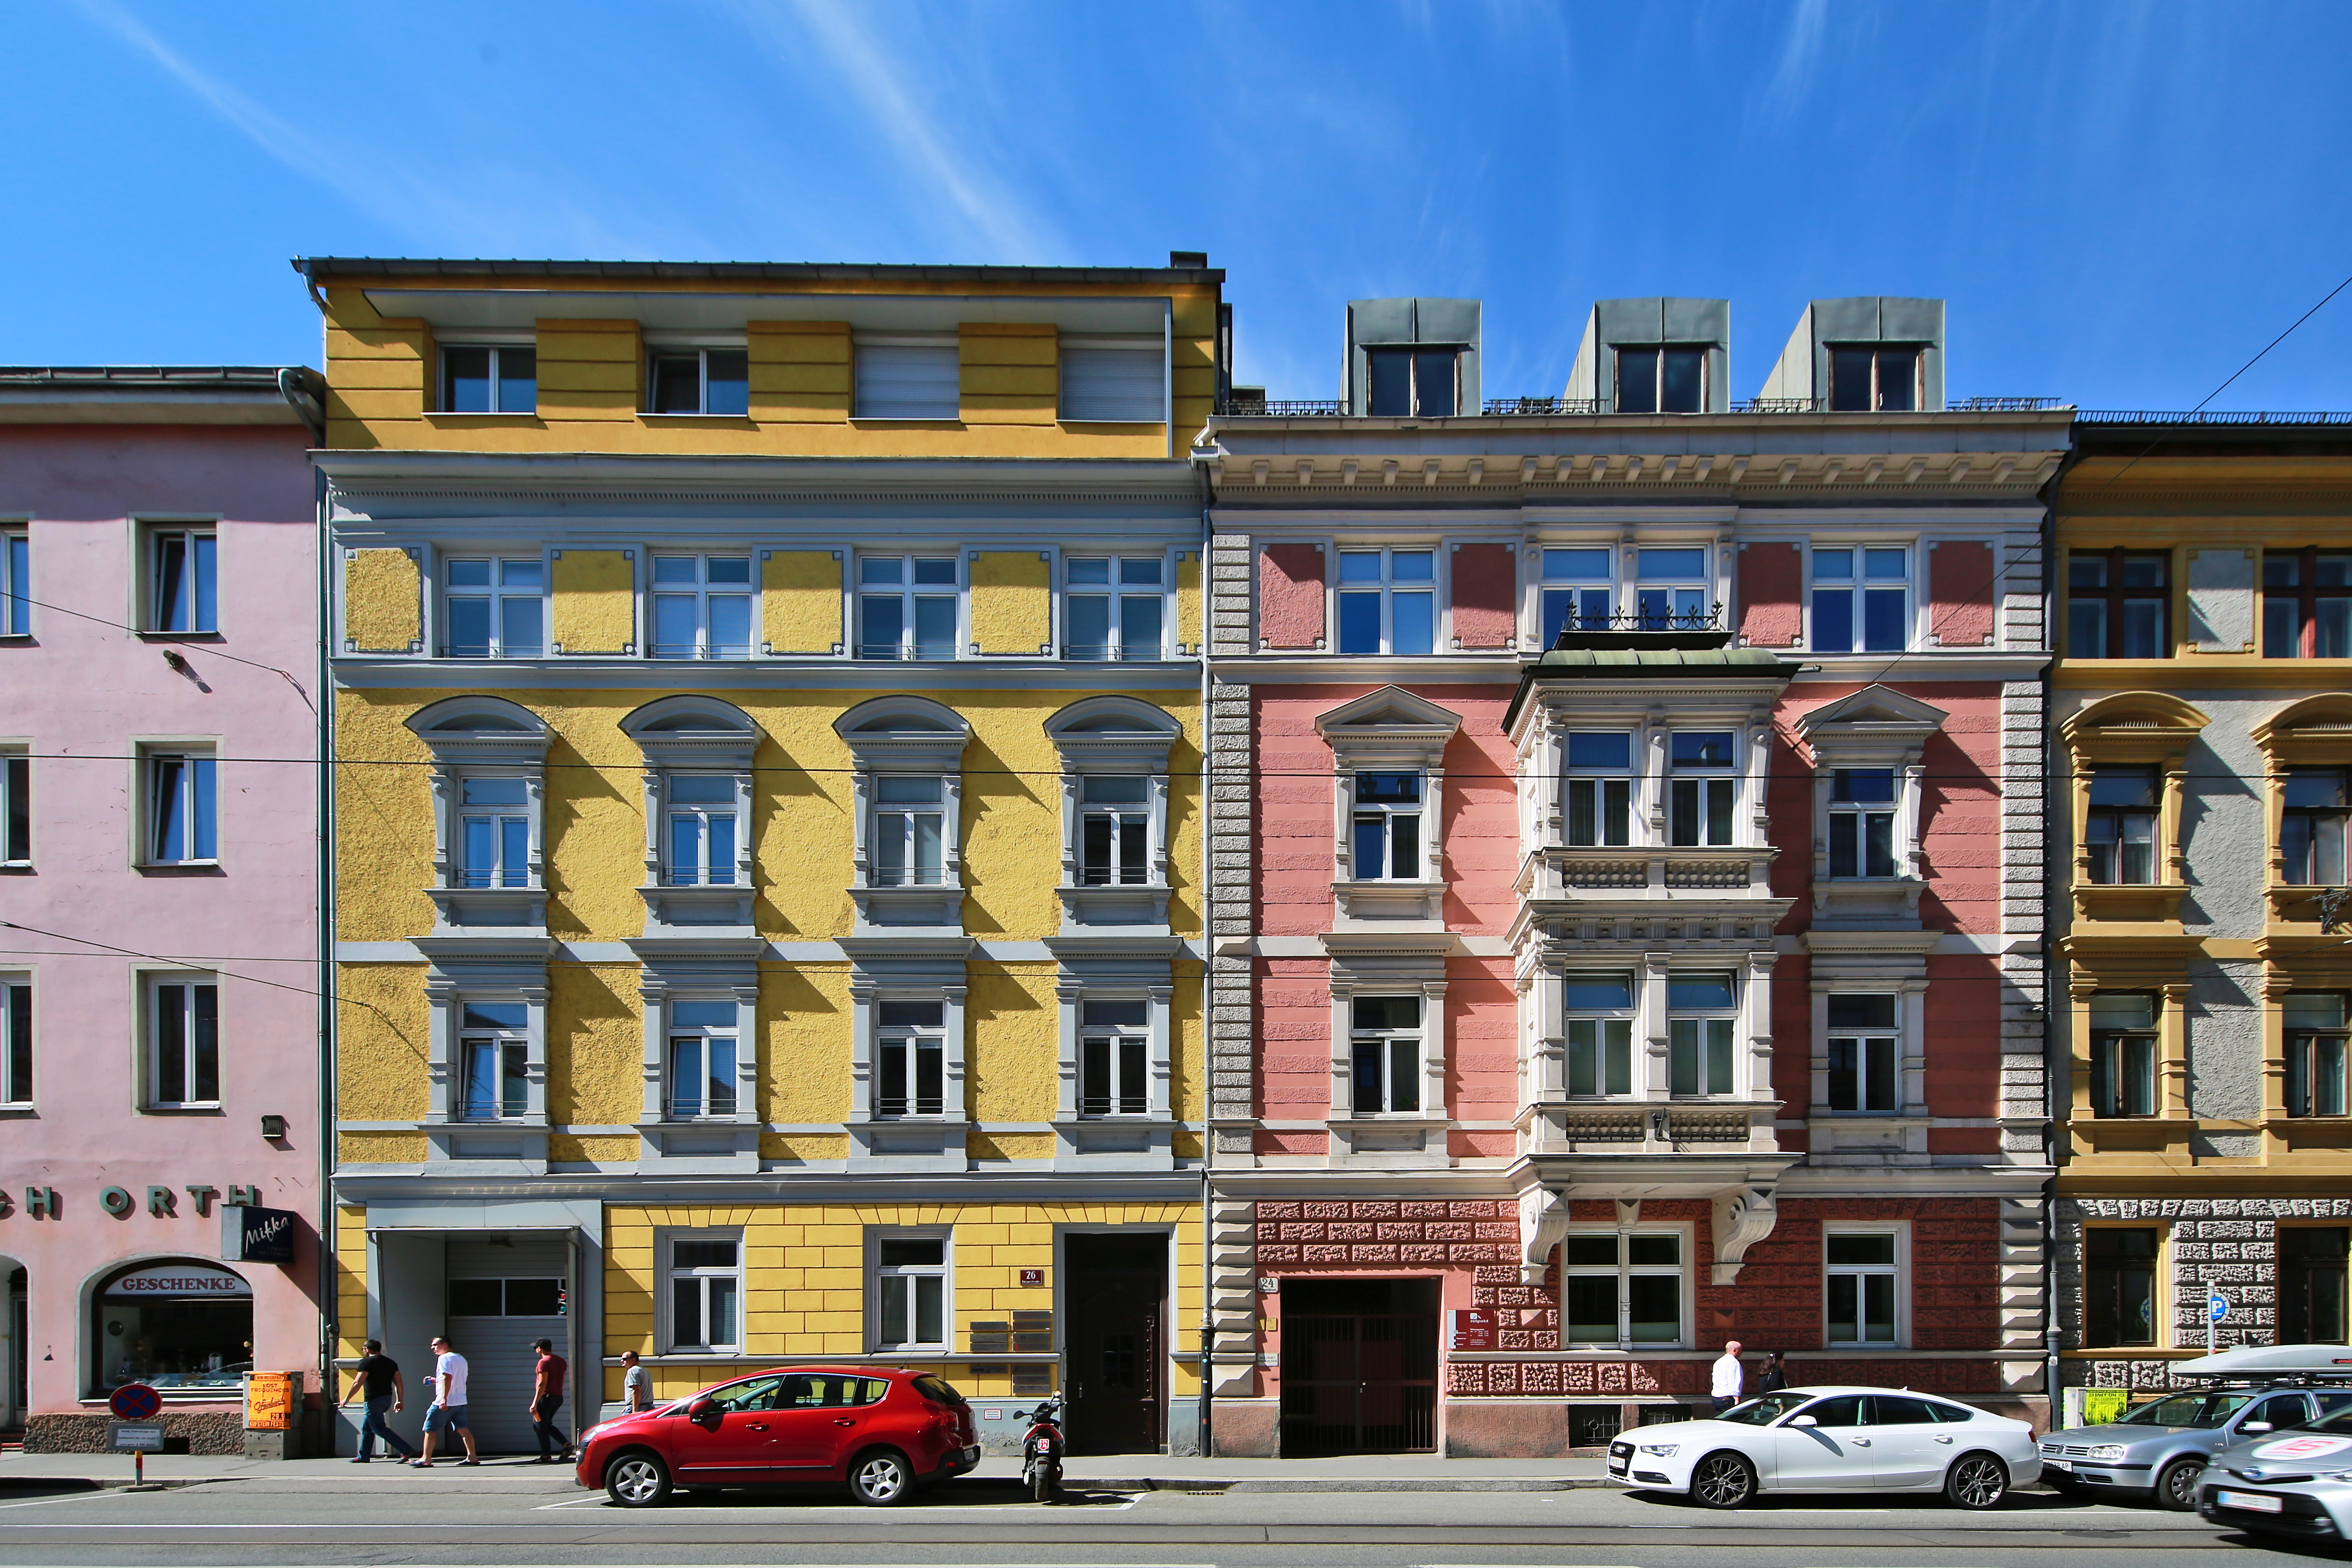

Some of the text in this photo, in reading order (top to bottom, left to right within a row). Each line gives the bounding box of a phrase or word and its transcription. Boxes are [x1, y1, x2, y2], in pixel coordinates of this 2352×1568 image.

[0, 1185, 255, 1214] H ORTH
[1026, 1271, 1036, 1279] 26
[122, 1278, 236, 1291] GESCHENKE
[1262, 1278, 1274, 1288] 24
[2212, 1300, 2223, 1313] P
